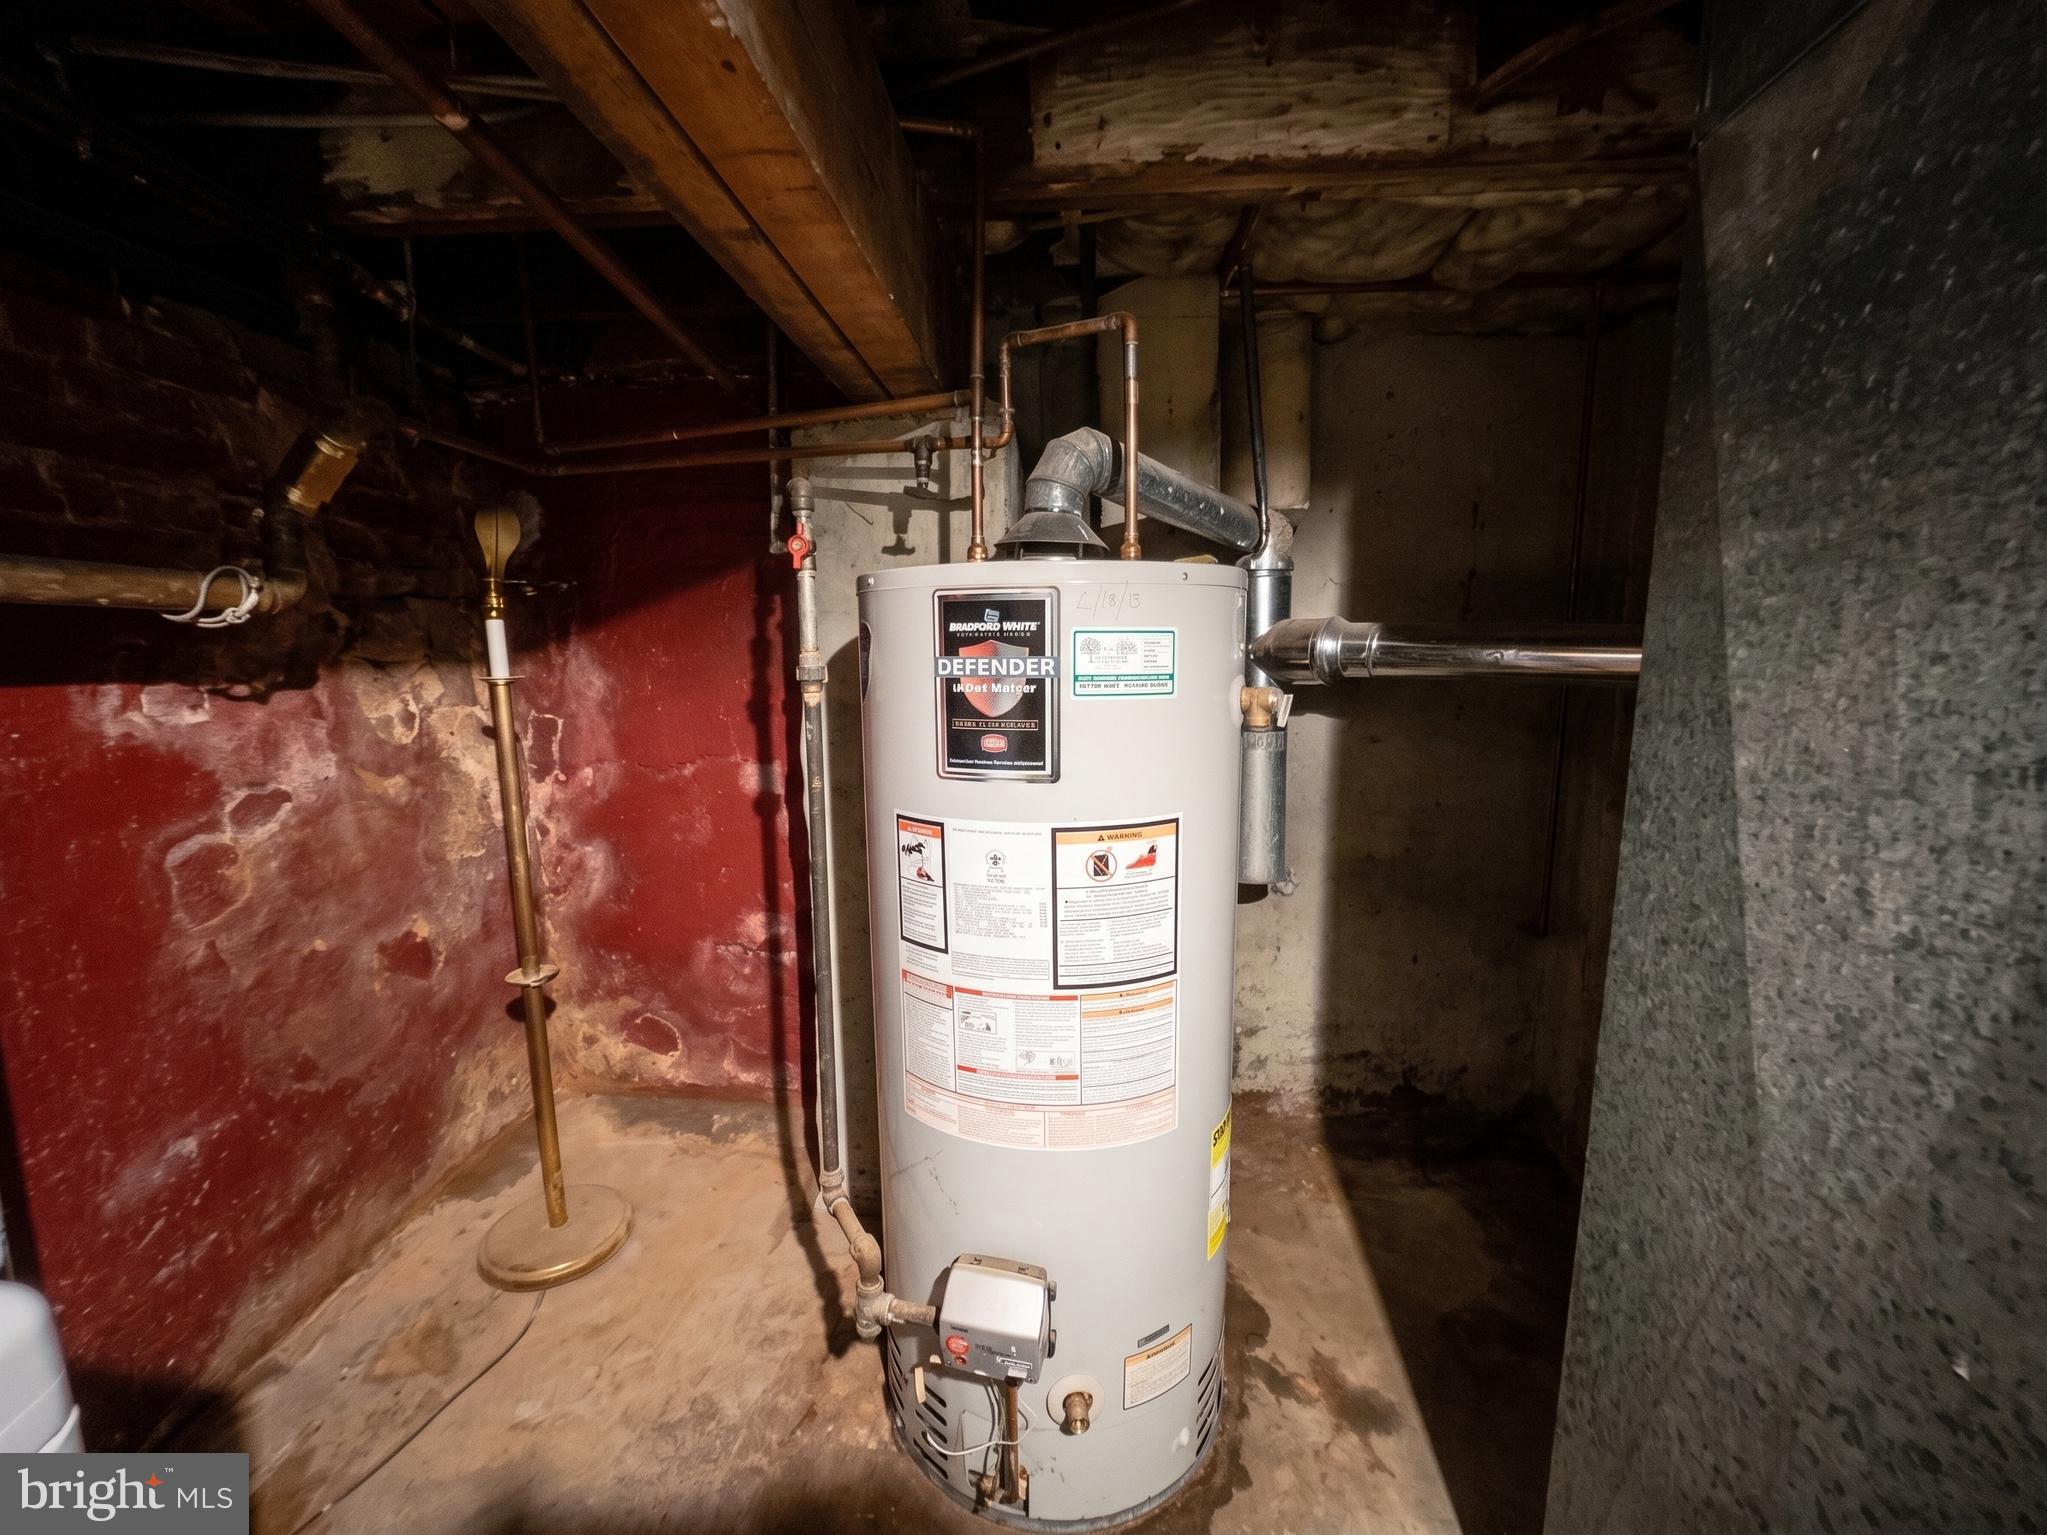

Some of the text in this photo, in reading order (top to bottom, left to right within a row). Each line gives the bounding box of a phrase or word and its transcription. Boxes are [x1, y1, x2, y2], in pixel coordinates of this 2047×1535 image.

[949, 621, 1038, 632] BRADFORD WHITE
[937, 658, 1056, 676] DEFENDER
[1107, 831, 1143, 841] WARNING
